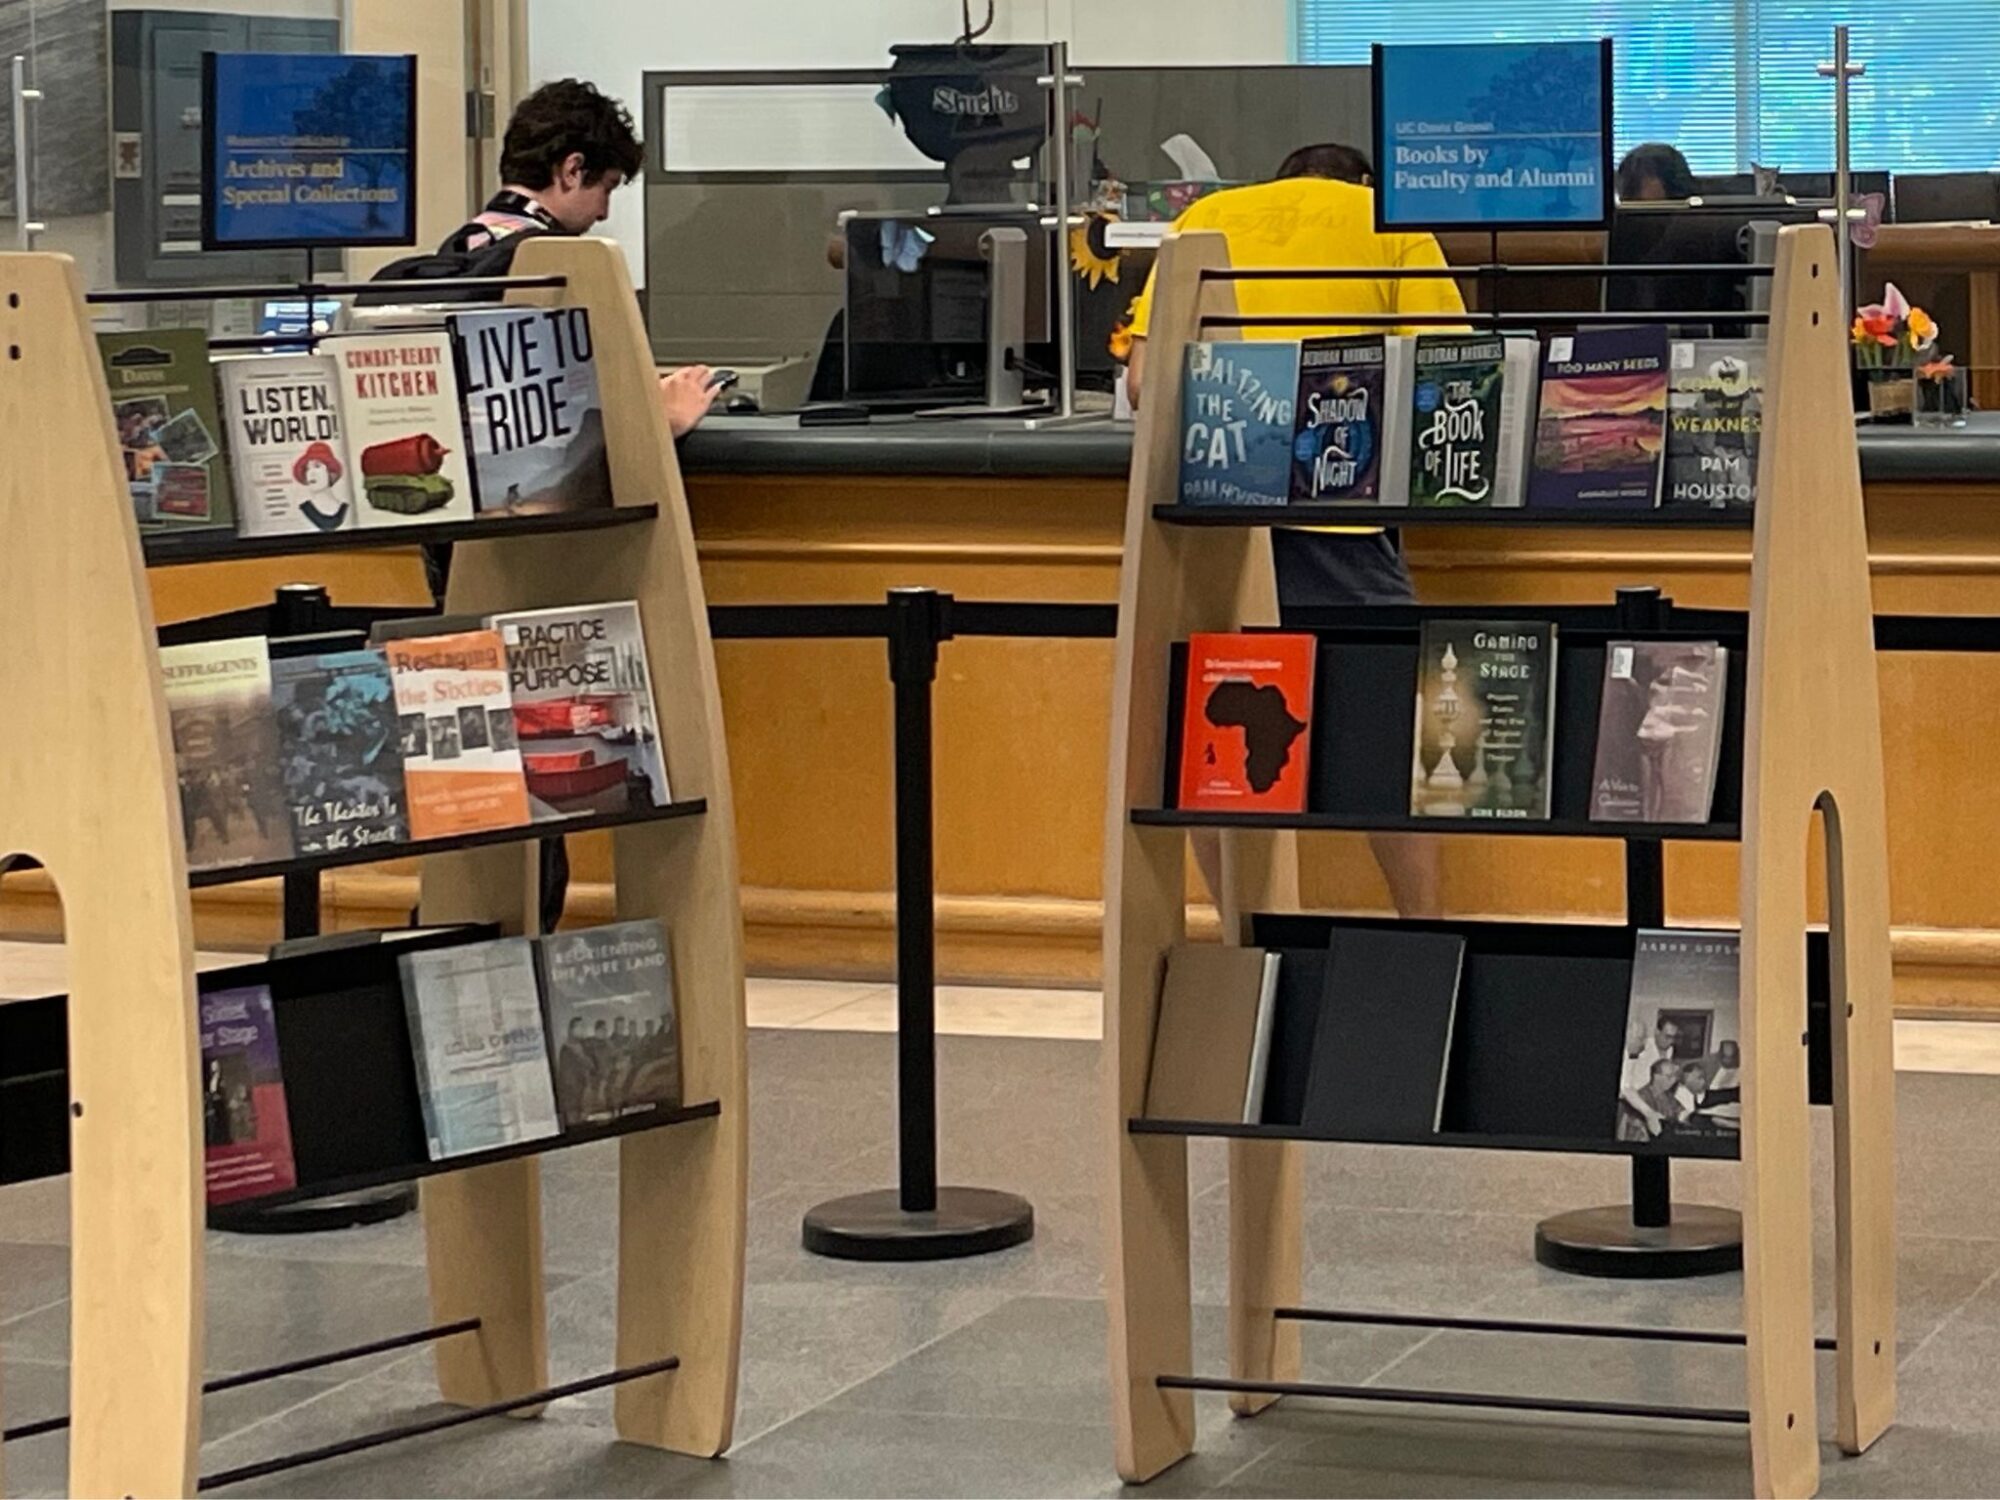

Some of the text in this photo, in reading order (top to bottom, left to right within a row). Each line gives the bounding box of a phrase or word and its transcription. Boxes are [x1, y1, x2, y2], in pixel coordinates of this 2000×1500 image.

[1395, 122, 1415, 133] UC
[225, 158, 344, 178] Archives and
[1395, 144, 1489, 168] Books by
[1394, 167, 1595, 194] Faculty and Alumni
[222, 184, 398, 209] Special Collections
[345, 347, 442, 368] COMBAT-READY
[464, 308, 593, 394] LIVE TO
[1557, 357, 1660, 374] TOO MANY SEEDS
[355, 371, 439, 399] KITCHEN
[1445, 380, 1473, 402] THE
[485, 376, 571, 455] RIDE
[1196, 393, 1233, 422] THE
[1307, 387, 1368, 428] SHADOW
[243, 414, 341, 445] WORLD!
[1334, 426, 1349, 447] OF
[1419, 399, 1485, 449] BOOK
[1671, 416, 1761, 433] WEAKNES
[1184, 420, 1248, 470] CAT
[1312, 446, 1358, 498] NIGHT
[1424, 443, 1489, 501] OF LIFE
[1701, 456, 1740, 472] PAM
[1184, 478, 1217, 495] PAM
[1672, 484, 1757, 500] HOUSTO
[517, 619, 606, 646] RACTICE
[395, 647, 498, 674] Restaging
[509, 648, 561, 669] WITH
[1480, 663, 1530, 679] STAGE
[510, 660, 611, 692] PURPOSE
[399, 676, 504, 706] the Sixties
[294, 804, 321, 827] The
[326, 831, 350, 850] the
[353, 825, 397, 848] Street
[625, 952, 667, 972] LAND
